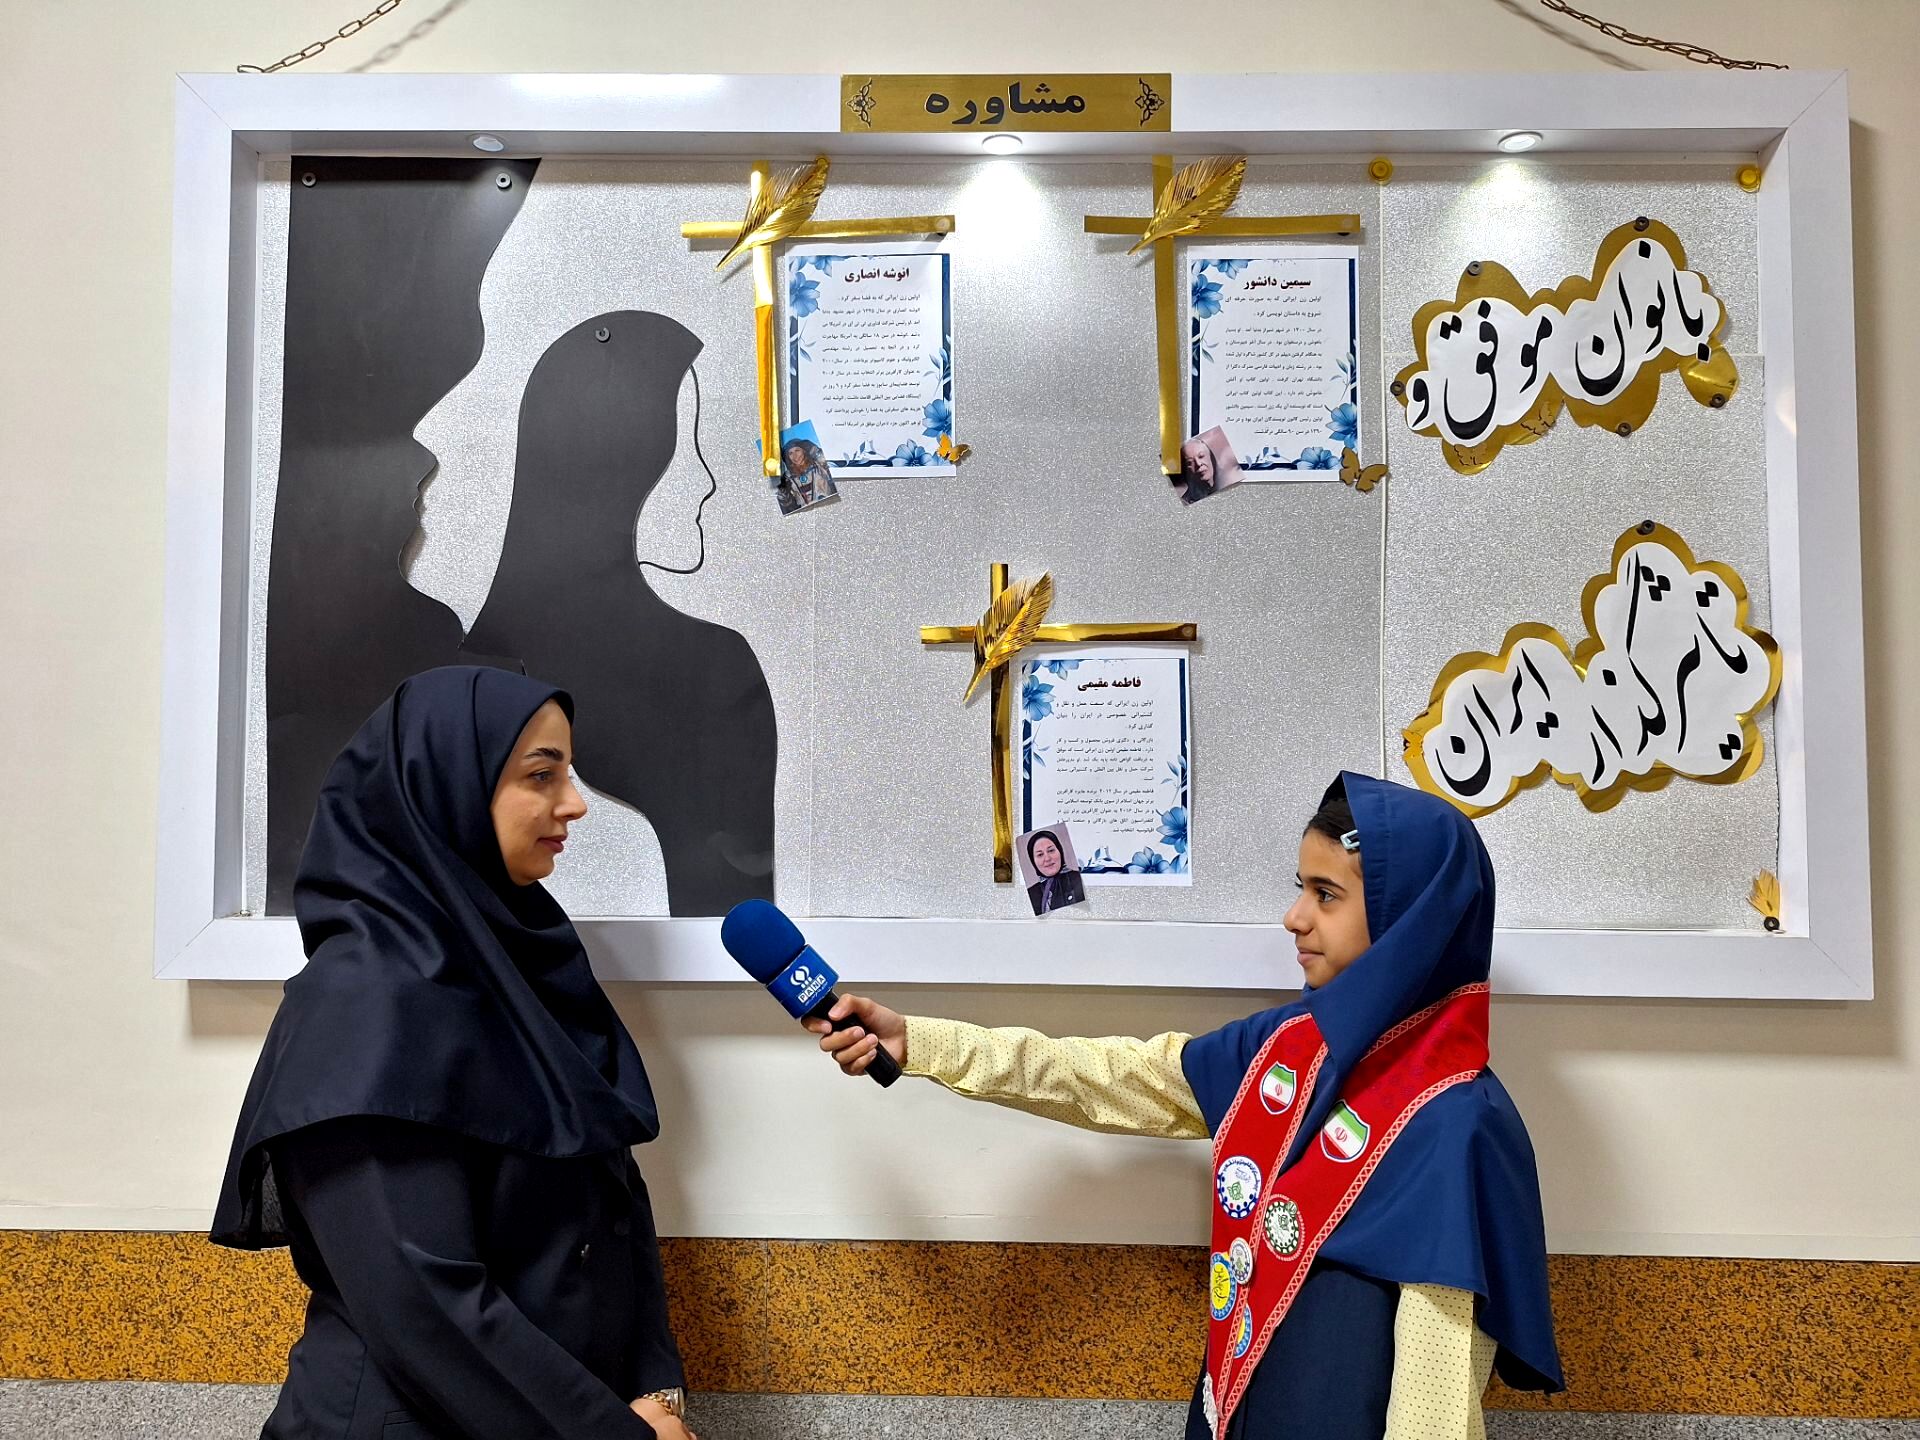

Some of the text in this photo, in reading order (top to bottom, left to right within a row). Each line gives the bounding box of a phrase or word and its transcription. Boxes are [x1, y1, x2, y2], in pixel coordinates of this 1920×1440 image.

[925, 81, 1086, 125] مشاوره
[844, 268, 910, 282] انوشه انصاری
[1243, 276, 1311, 290] سیمین دانشور
[1412, 240, 1711, 441] بانوان موفق و
[1077, 676, 1142, 691] فاطمه مقیمی
[1434, 647, 1560, 797] ایران
[798, 974, 826, 1004] PANA
